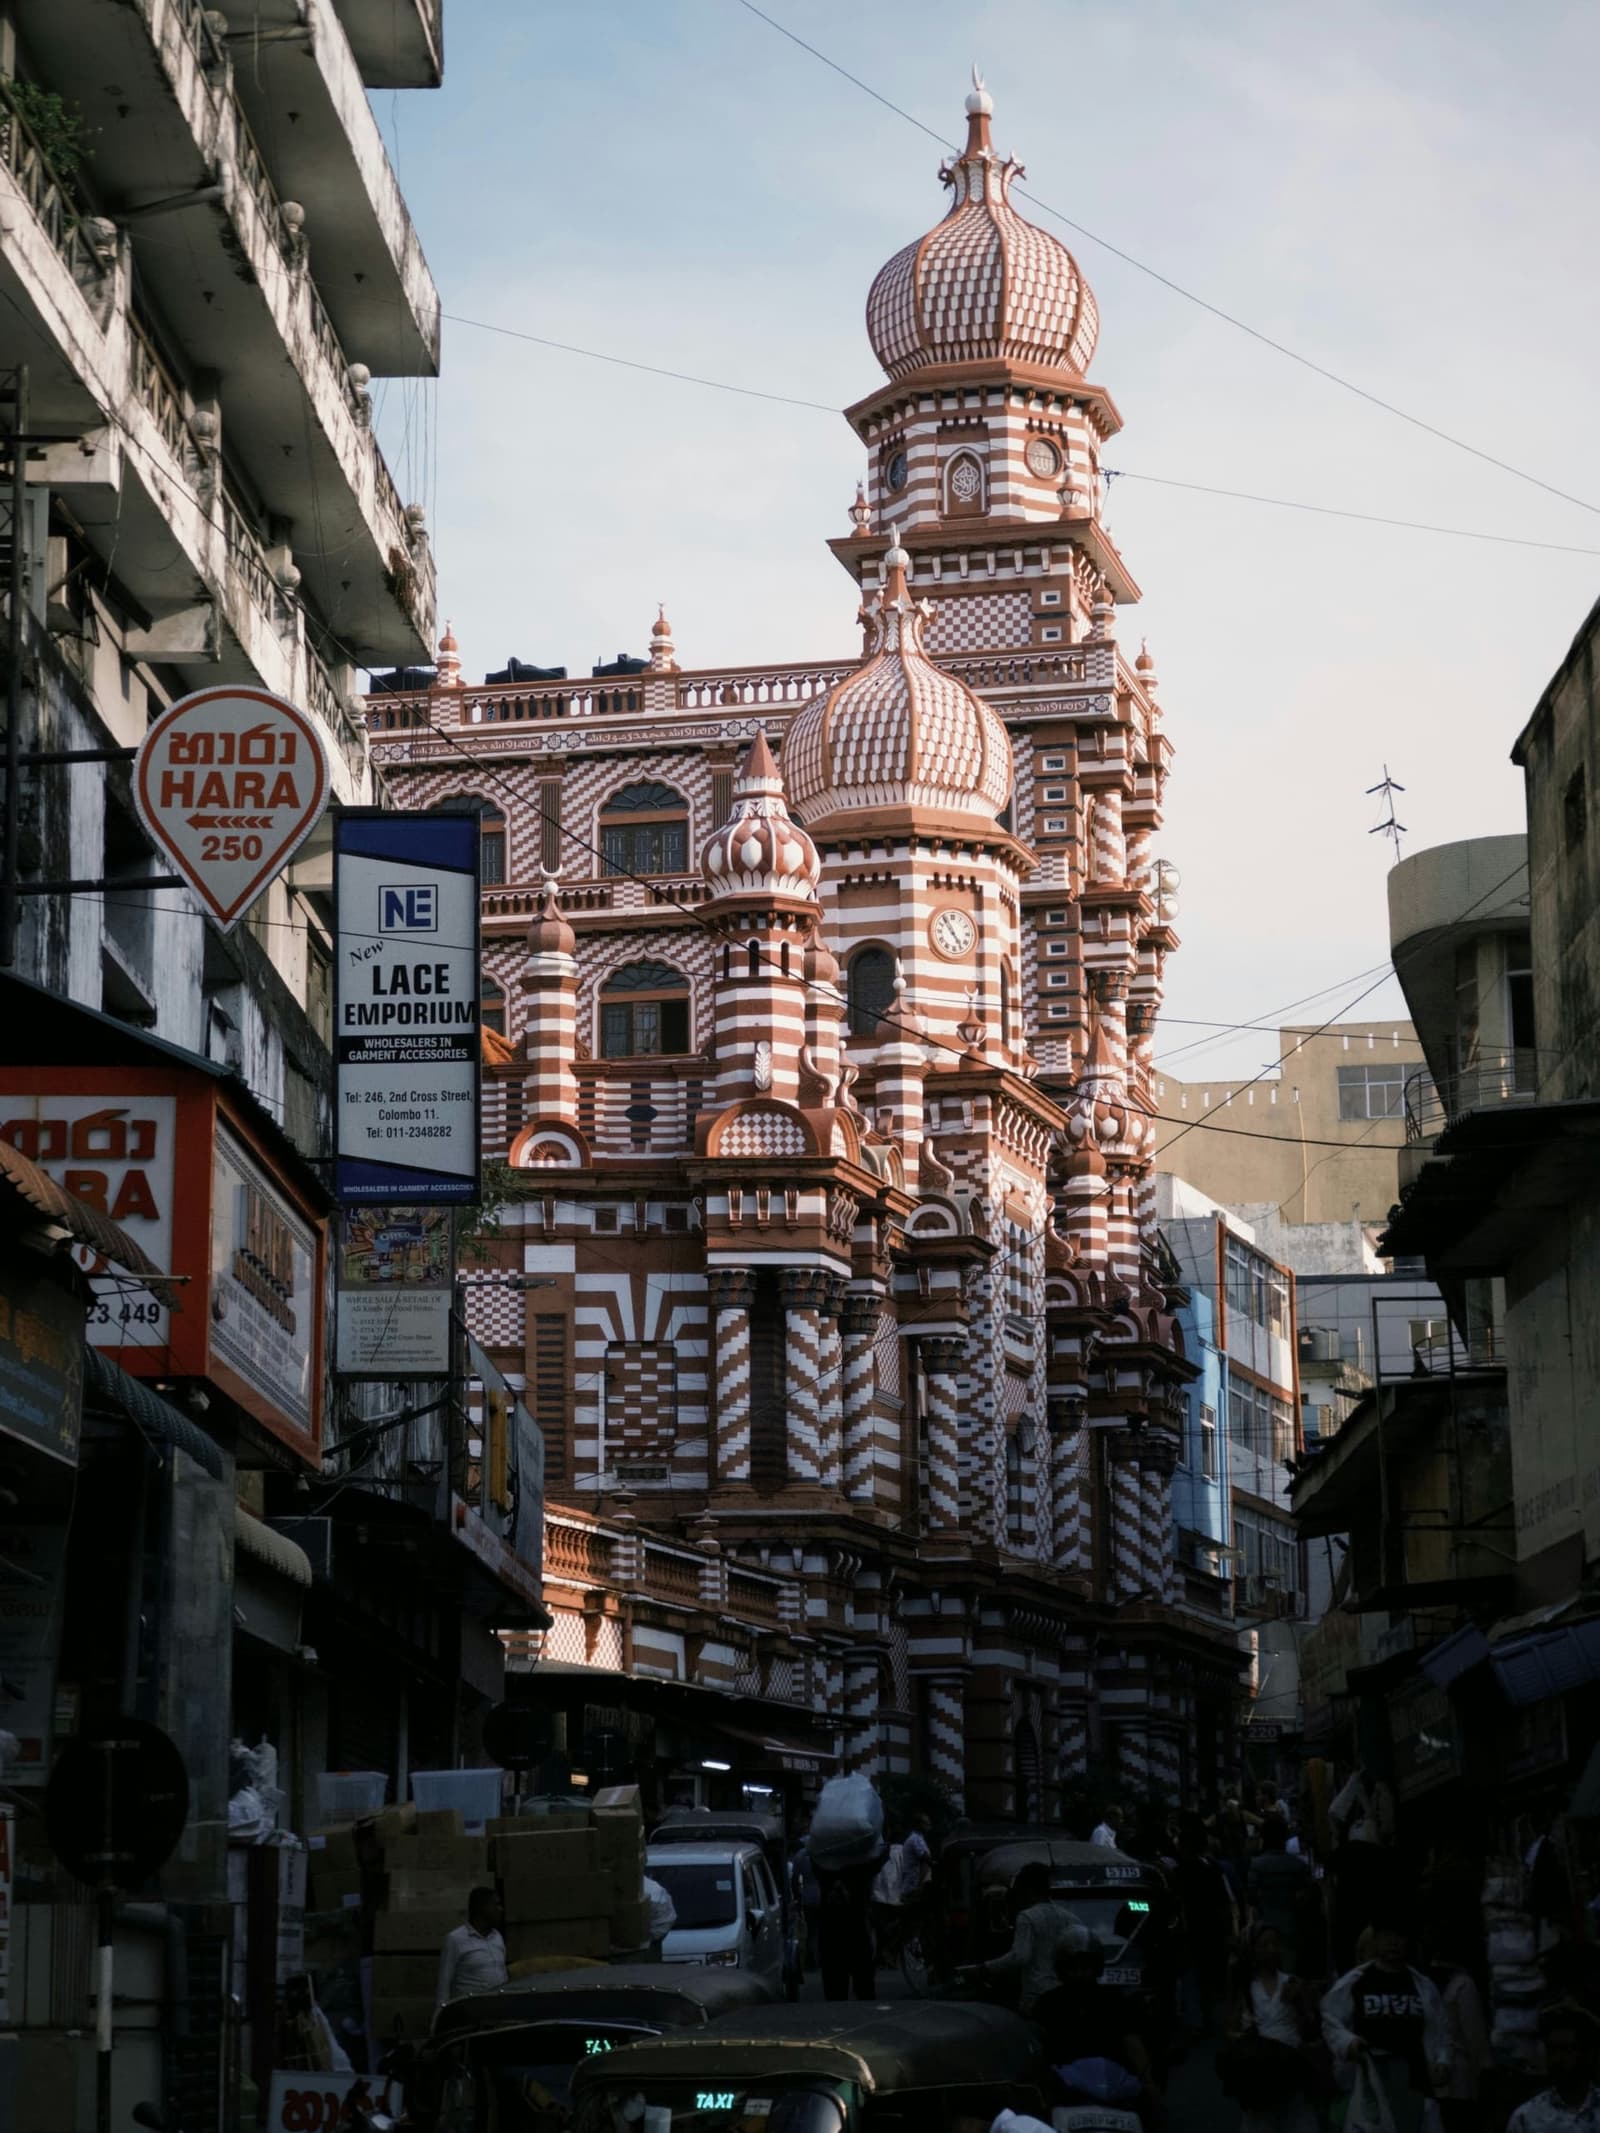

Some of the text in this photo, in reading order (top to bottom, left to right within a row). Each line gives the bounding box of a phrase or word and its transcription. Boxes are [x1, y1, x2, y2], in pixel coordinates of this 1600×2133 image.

[160, 770, 301, 809] HARA
[201, 834, 263, 861] 250
[349, 940, 384, 967] New
[372, 963, 450, 995] LACE
[344, 1001, 479, 1026] EMPORIUM
[364, 1037, 452, 1049] WHOLESALERS IN
[348, 1048, 468, 1061] GARMENT ACCESSORIES
[345, 1090, 473, 1105] Tel: 246, 2nd Cross Street,
[378, 1109, 439, 1120] Colombo 11.
[367, 1126, 452, 1138] Tel: 011-2348282
[119, 1302, 161, 1324] 449
[1127, 1900, 1150, 1912] TAXI
[695, 2093, 736, 2109] TAXI
